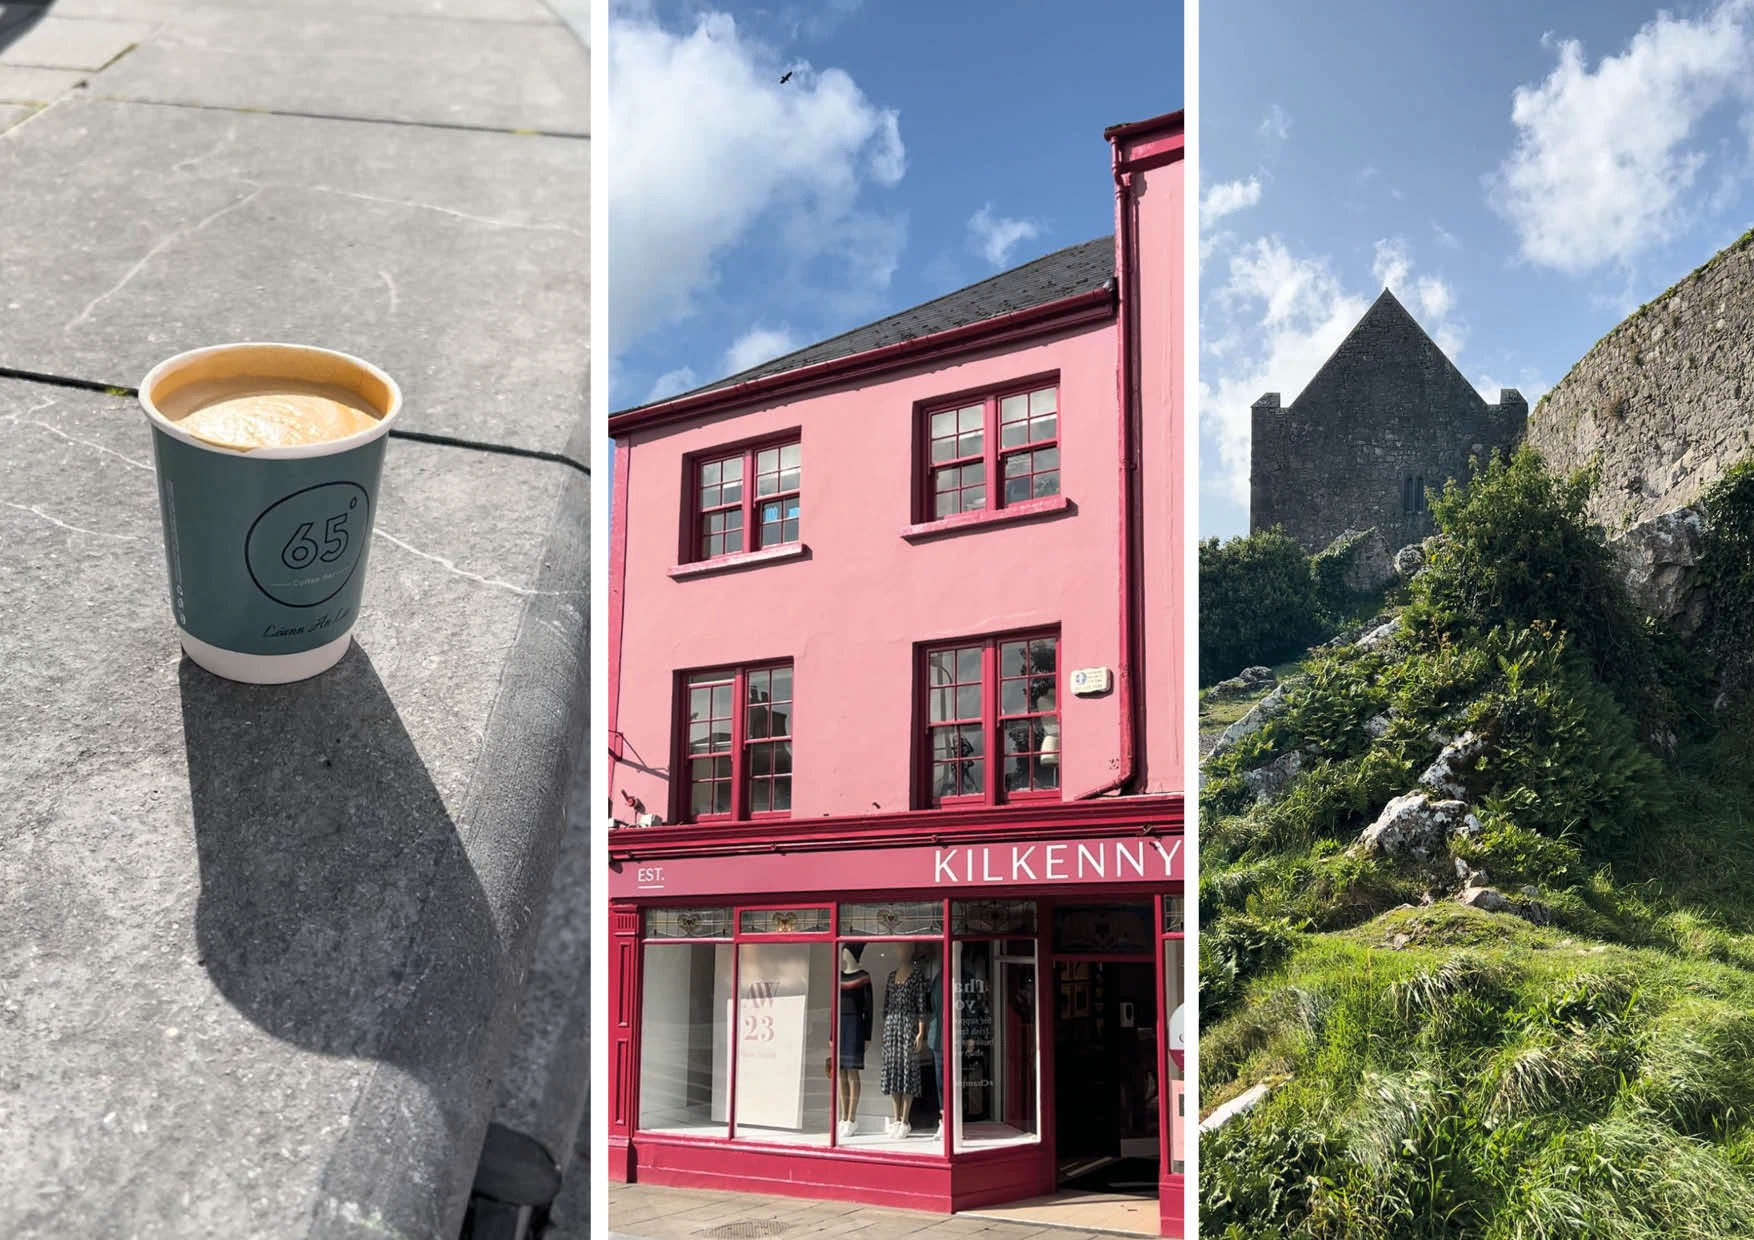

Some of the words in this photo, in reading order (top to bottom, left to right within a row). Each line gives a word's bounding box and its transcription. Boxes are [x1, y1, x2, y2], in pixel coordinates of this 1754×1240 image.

[637, 867, 665, 882] EST.
[934, 839, 1182, 883] KILKENNY
[744, 981, 780, 1009] AW
[744, 1015, 775, 1041] 23
